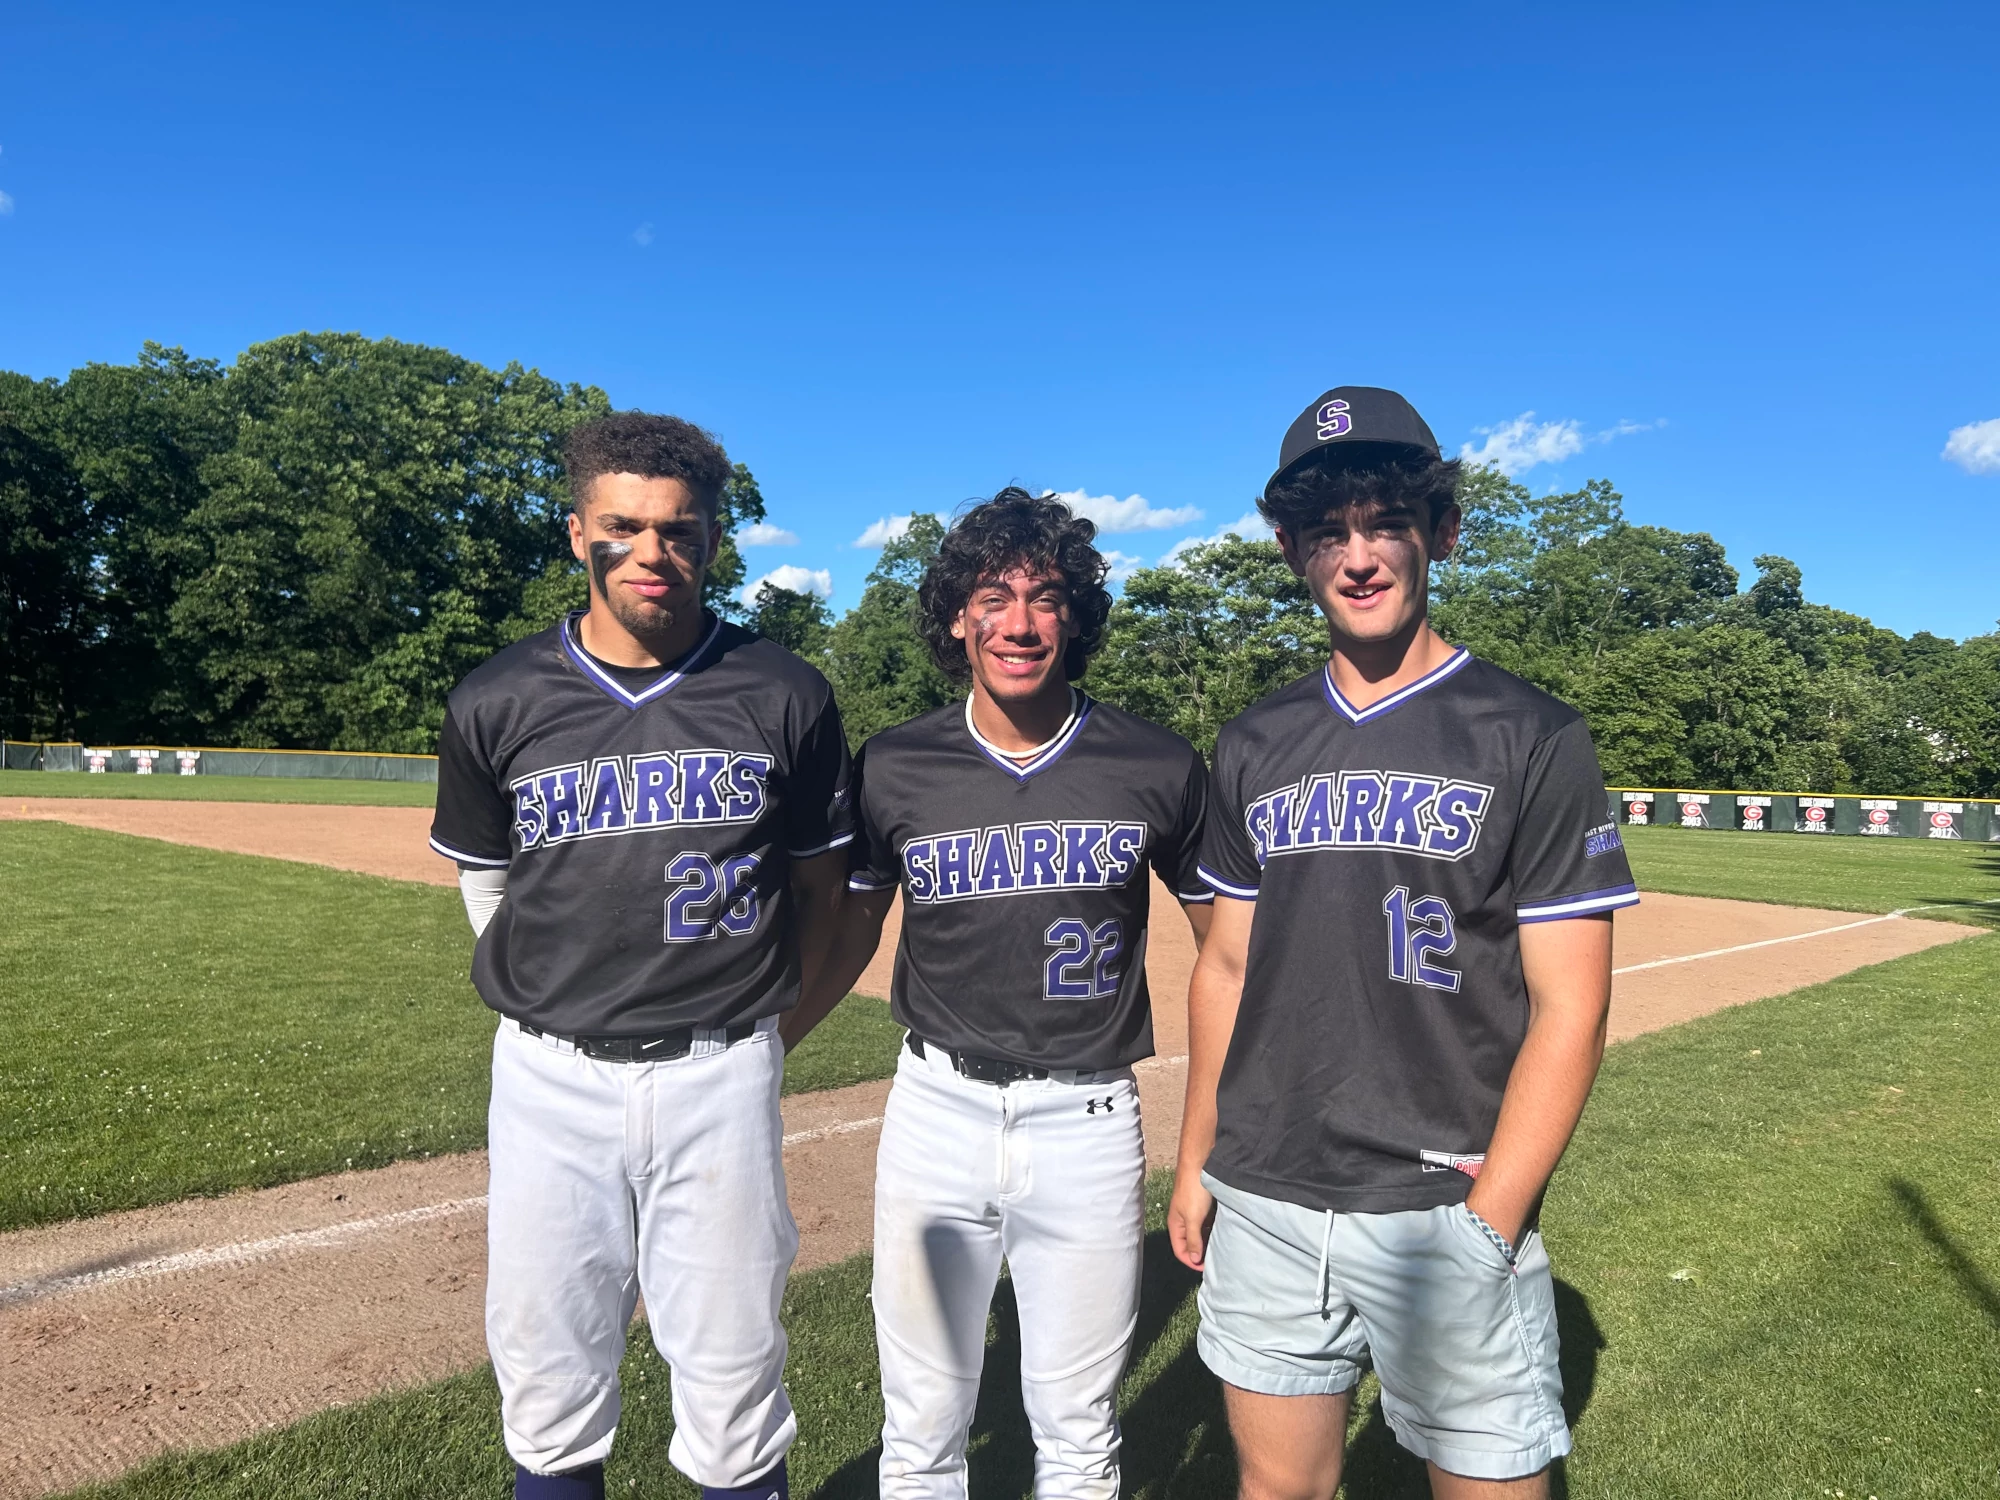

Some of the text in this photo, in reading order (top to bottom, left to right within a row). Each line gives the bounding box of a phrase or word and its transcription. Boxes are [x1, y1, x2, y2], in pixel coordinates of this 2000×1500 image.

[1317, 399, 1352, 440] S
[509, 748, 774, 852] SHARKS
[1629, 801, 1647, 815] G
[1683, 802, 1701, 817] G
[1743, 805, 1763, 820] G
[1805, 807, 1825, 821] G
[1245, 770, 1494, 871] SHARKS
[1681, 816, 1701, 826] 2003
[1869, 809, 1889, 824] G
[1930, 811, 1953, 827] G
[1585, 822, 1615, 838] EAST RIVER
[1742, 819, 1763, 830] 2014
[1804, 821, 1826, 832] 2015
[1868, 823, 1889, 834] 2016
[1929, 827, 1953, 838] 2017
[1585, 829, 1623, 859] SHA
[901, 820, 1147, 904] SHARKS
[664, 851, 760, 943] 26
[1383, 885, 1461, 993] 12
[1043, 918, 1123, 1000] 22
